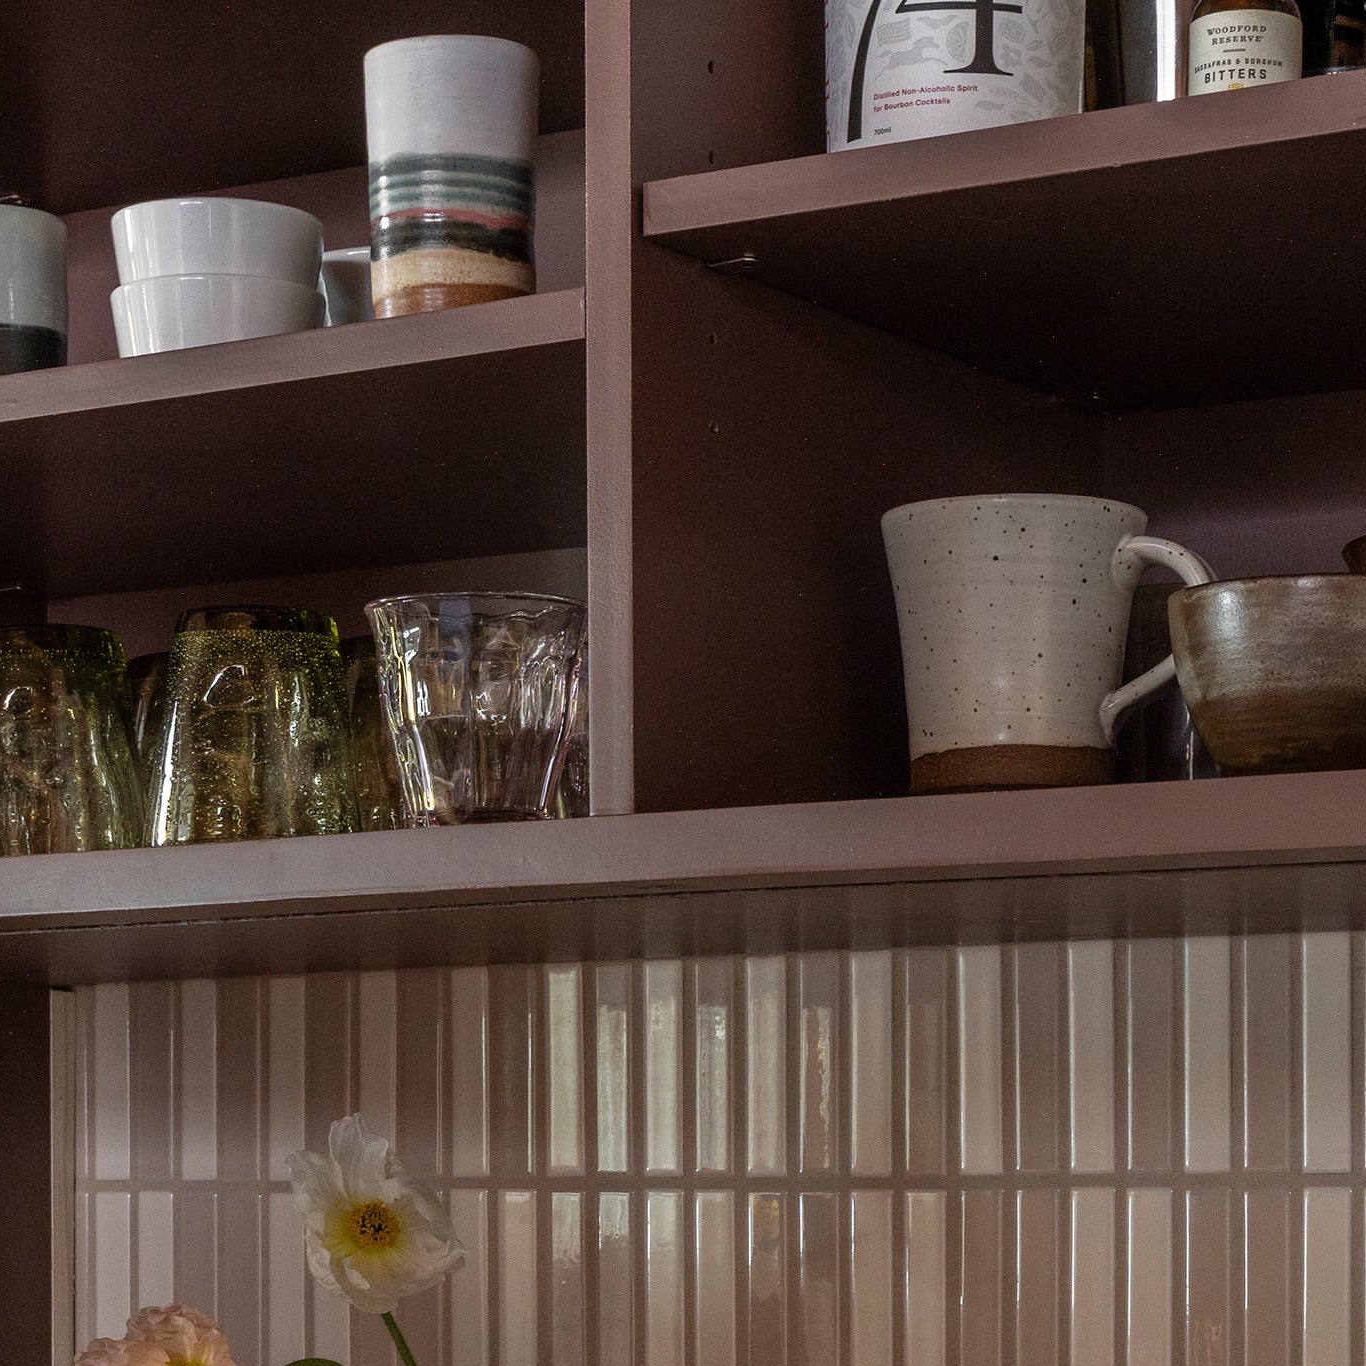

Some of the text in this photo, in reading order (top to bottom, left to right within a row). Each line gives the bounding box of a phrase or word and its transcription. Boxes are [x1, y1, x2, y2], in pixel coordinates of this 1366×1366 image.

[1206, 25, 1267, 36] WOODFORD
[1211, 35, 1263, 46] RESERVE
[1194, 59, 1232, 73] SASSAFRAS
[1245, 58, 1283, 67] SORGHUM
[1204, 68, 1267, 84] BITTERS
[873, 85, 978, 100] Distilled Non-Alcoholic Spirit
[873, 98, 951, 113] for Bourbon Cocktails
